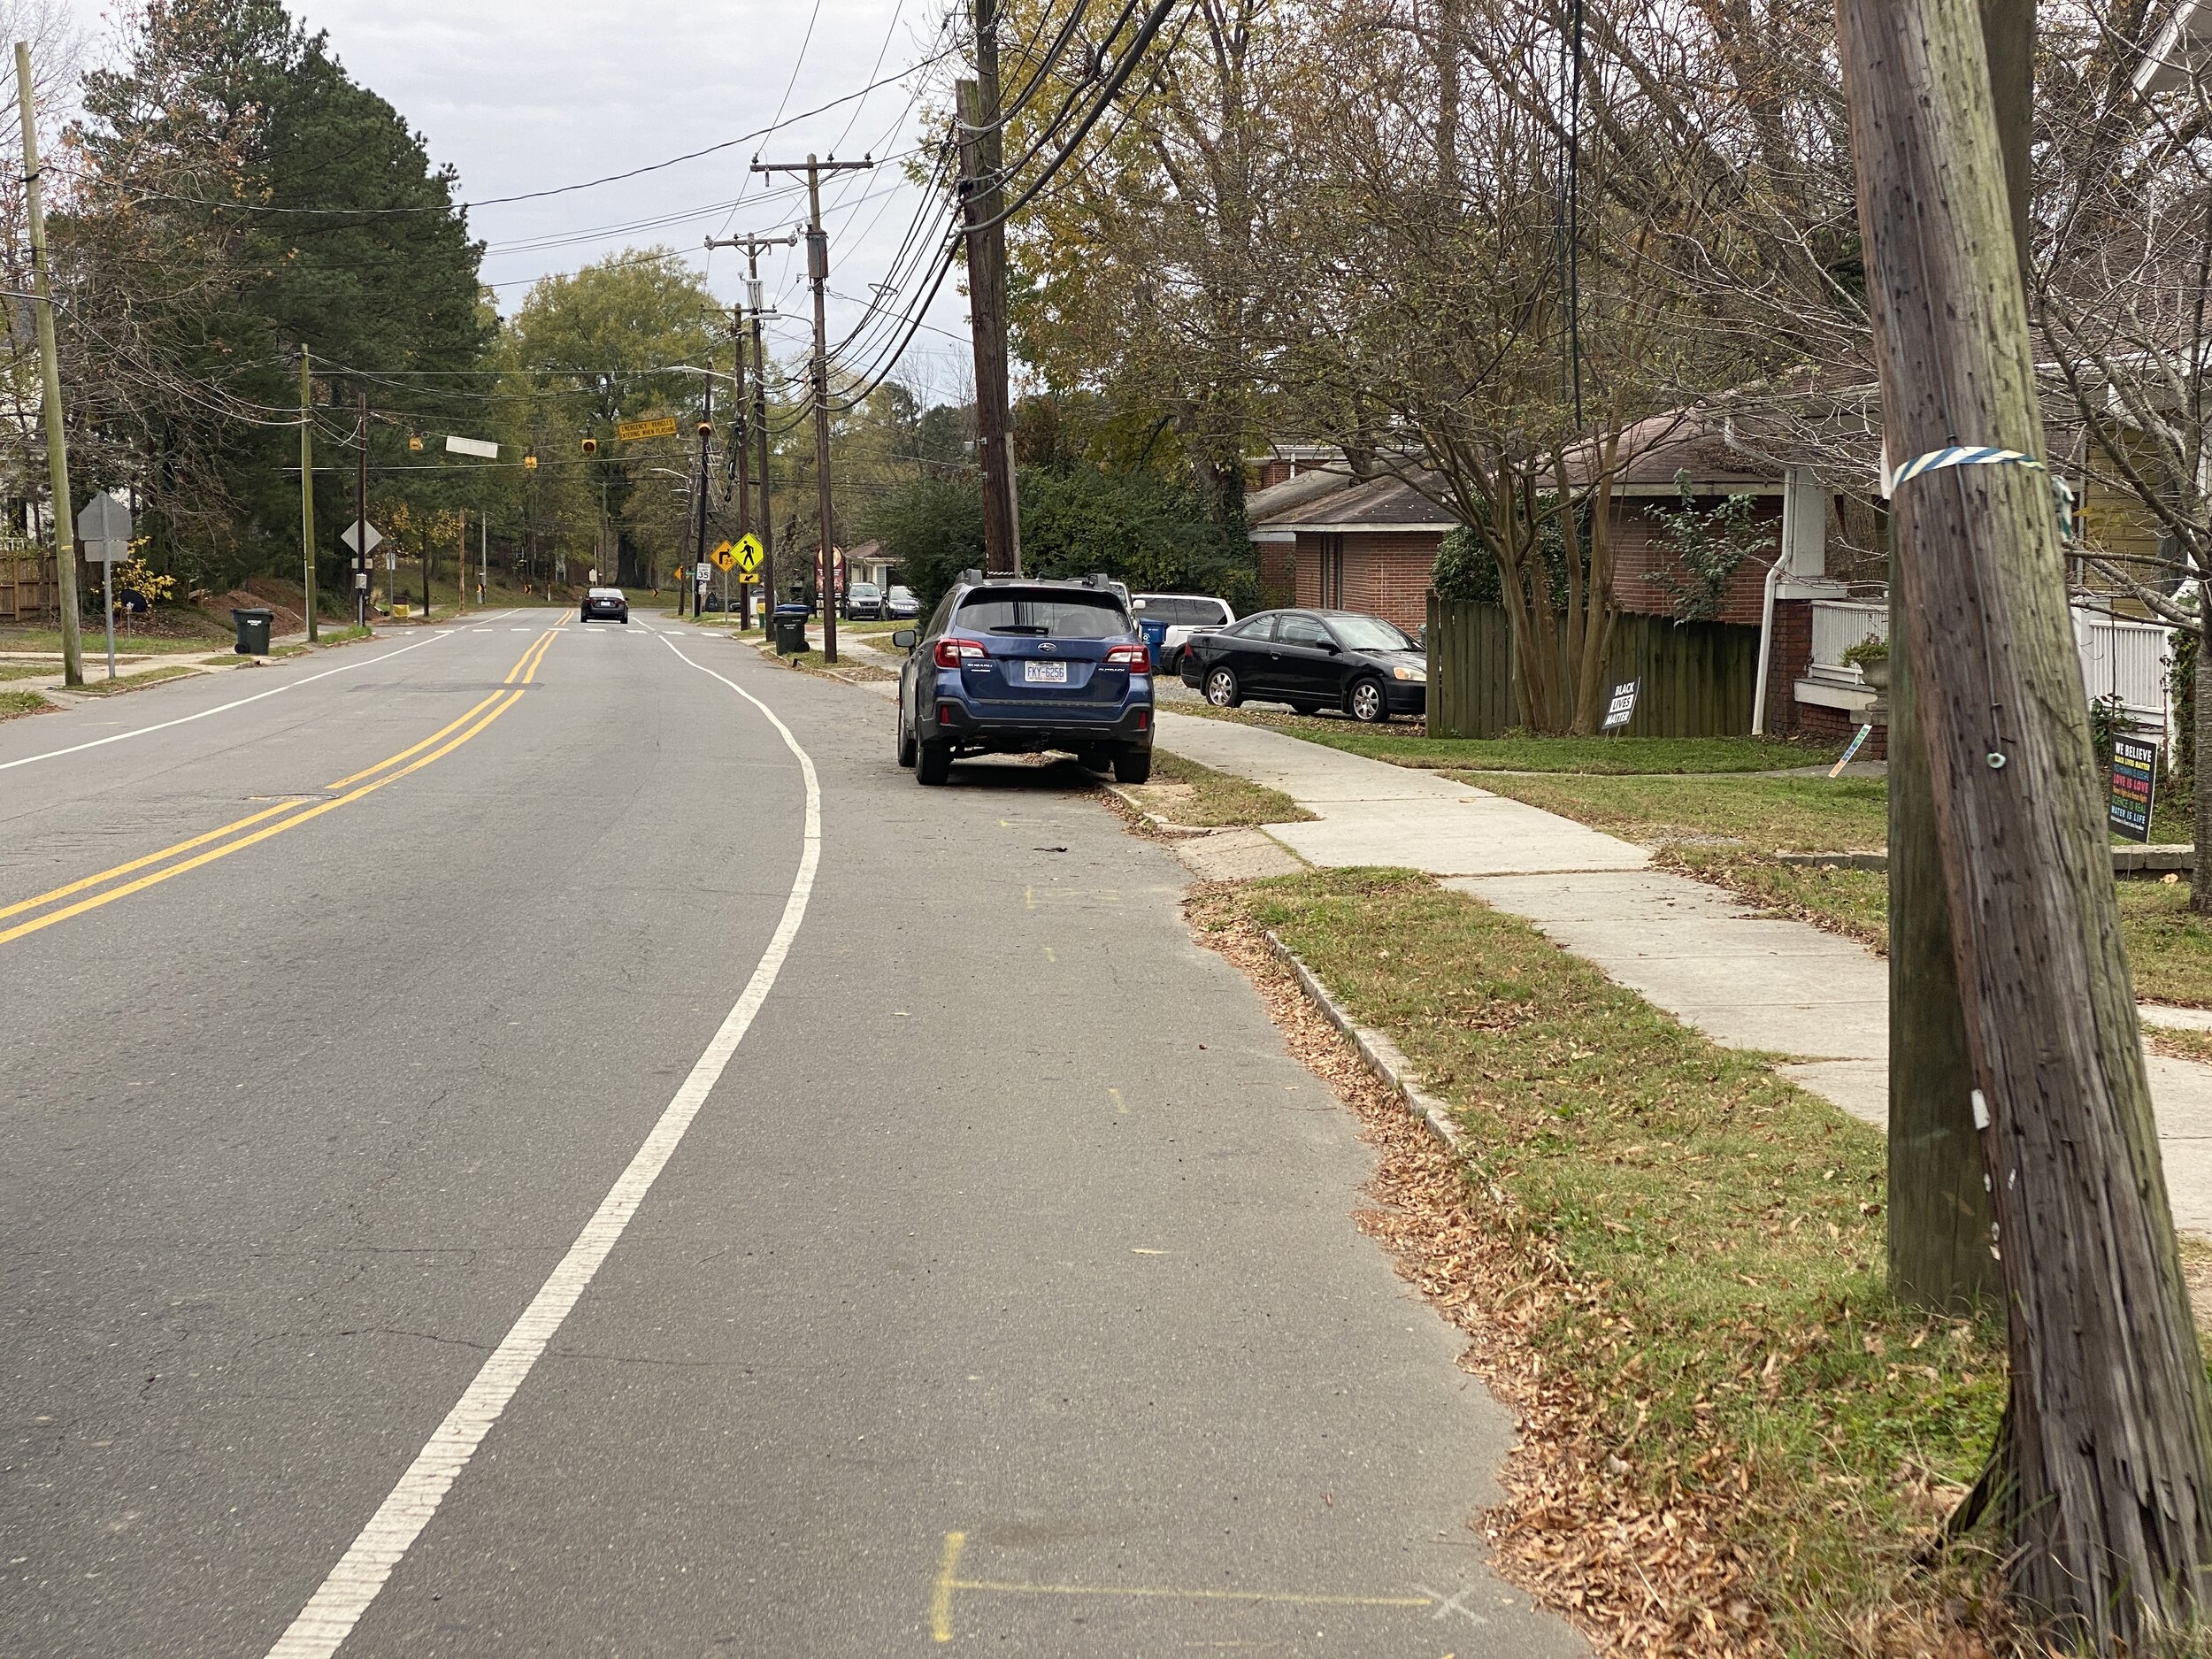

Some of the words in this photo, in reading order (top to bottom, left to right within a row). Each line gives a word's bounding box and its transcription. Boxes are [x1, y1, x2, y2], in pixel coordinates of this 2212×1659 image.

[1615, 681, 1635, 696] BLACK
[1613, 697, 1631, 710] LIVES
[1605, 711, 1630, 726] MATTER
[2116, 742, 2124, 755] WE
[2125, 745, 2152, 762] BELIEVE
[2113, 773, 2125, 787] LOVE
[2127, 777, 2132, 788] IS
[2133, 780, 2149, 793] LOVE
[2112, 805, 2126, 818] WATER
[2127, 811, 2132, 820] IS
[2134, 813, 2146, 824] LIFE
